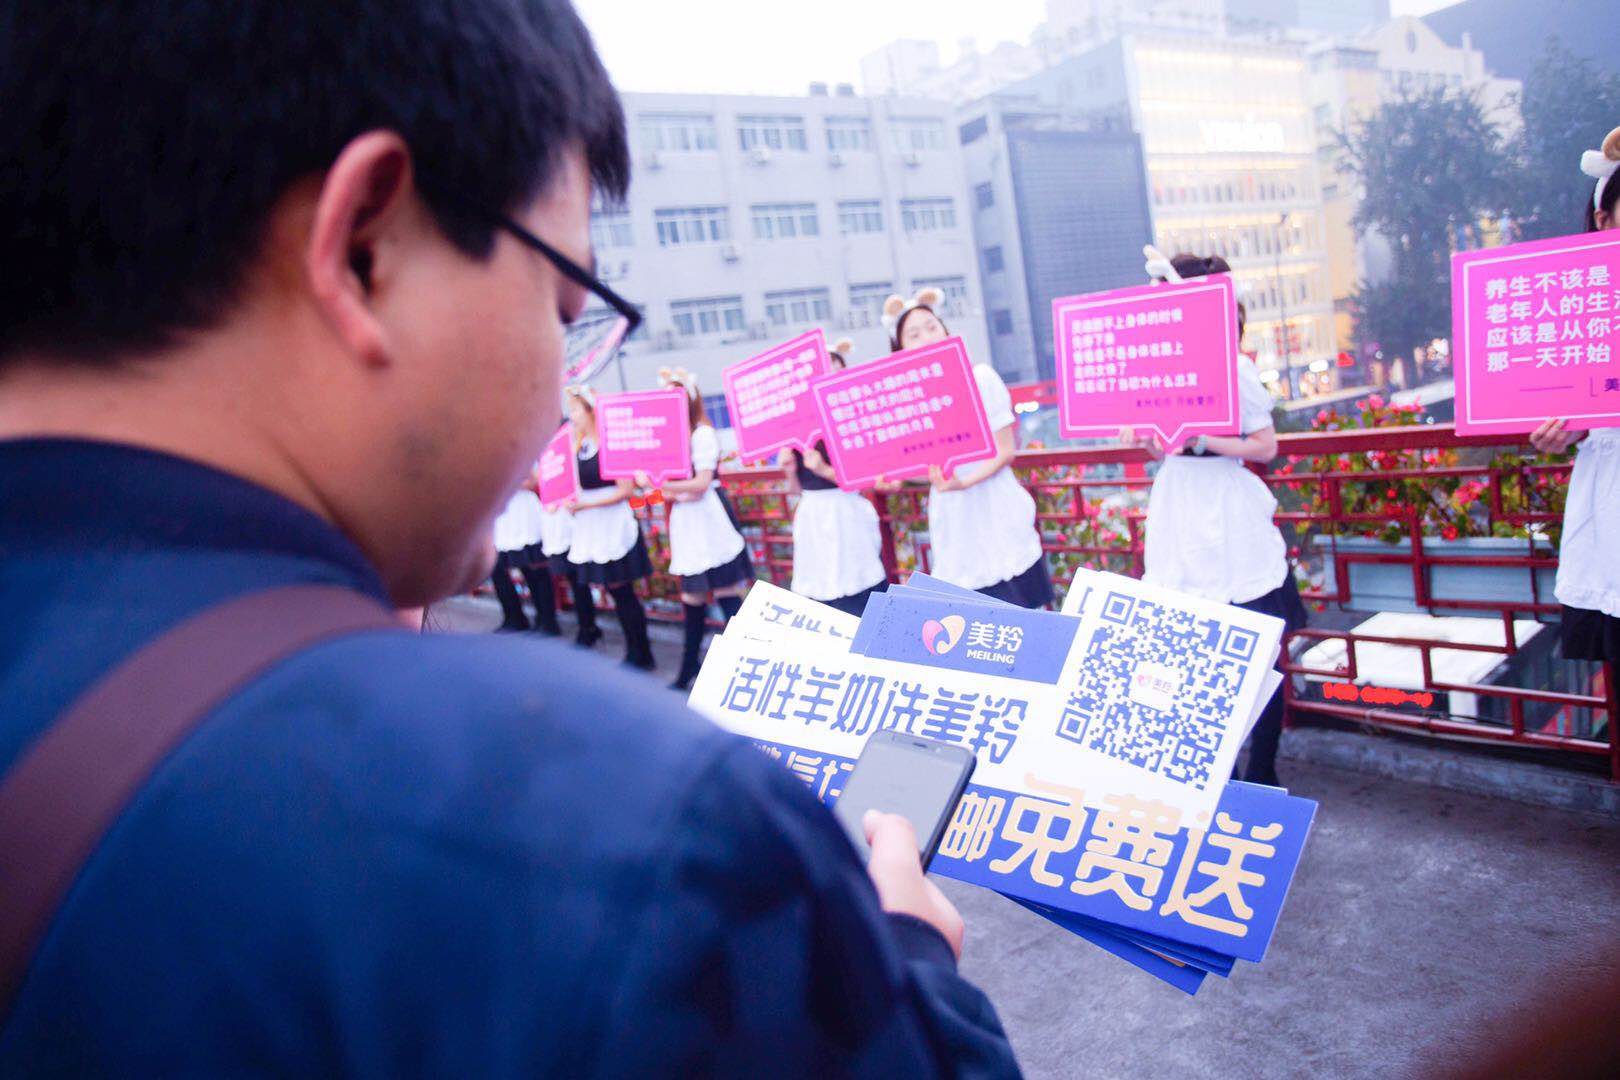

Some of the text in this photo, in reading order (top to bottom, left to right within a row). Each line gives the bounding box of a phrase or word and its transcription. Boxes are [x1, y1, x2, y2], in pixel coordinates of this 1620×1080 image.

[1485, 265, 1610, 300] 养生不该是
[1486, 314, 1620, 348] 应该是从你
[1487, 343, 1611, 373] 那一天开始
[966, 620, 1024, 652] 美羚
[966, 649, 1016, 665] MEILING
